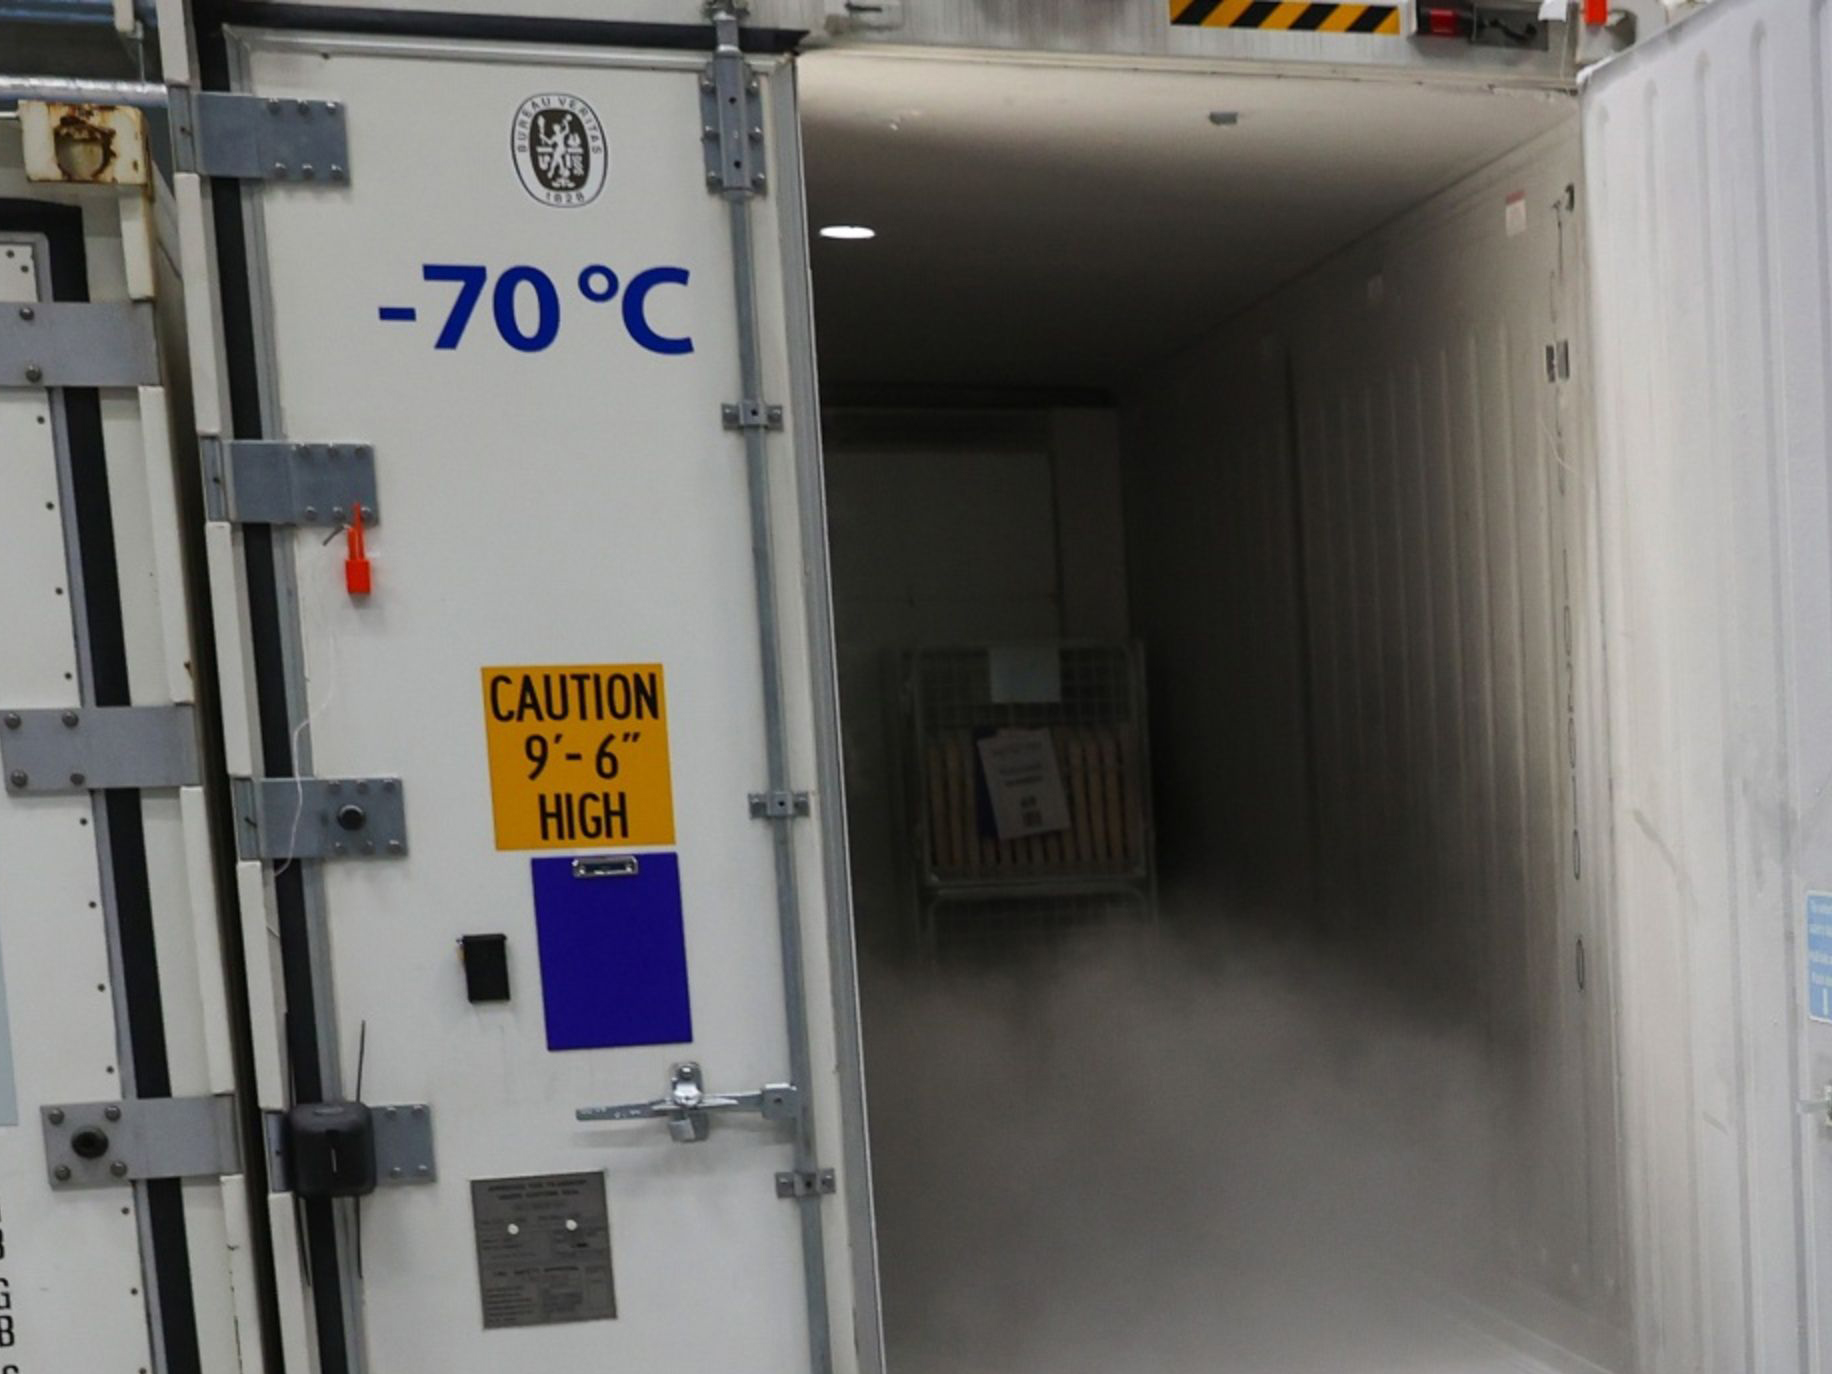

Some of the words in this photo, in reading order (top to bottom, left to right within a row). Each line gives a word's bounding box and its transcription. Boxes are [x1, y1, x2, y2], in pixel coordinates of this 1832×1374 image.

[518, 97, 551, 153] BUREAU
[558, 98, 603, 154] VERITAS
[378, 264, 560, 352] -70
[577, 264, 694, 355] °C
[490, 672, 660, 722] CAUTION
[538, 792, 629, 841] HIGH
